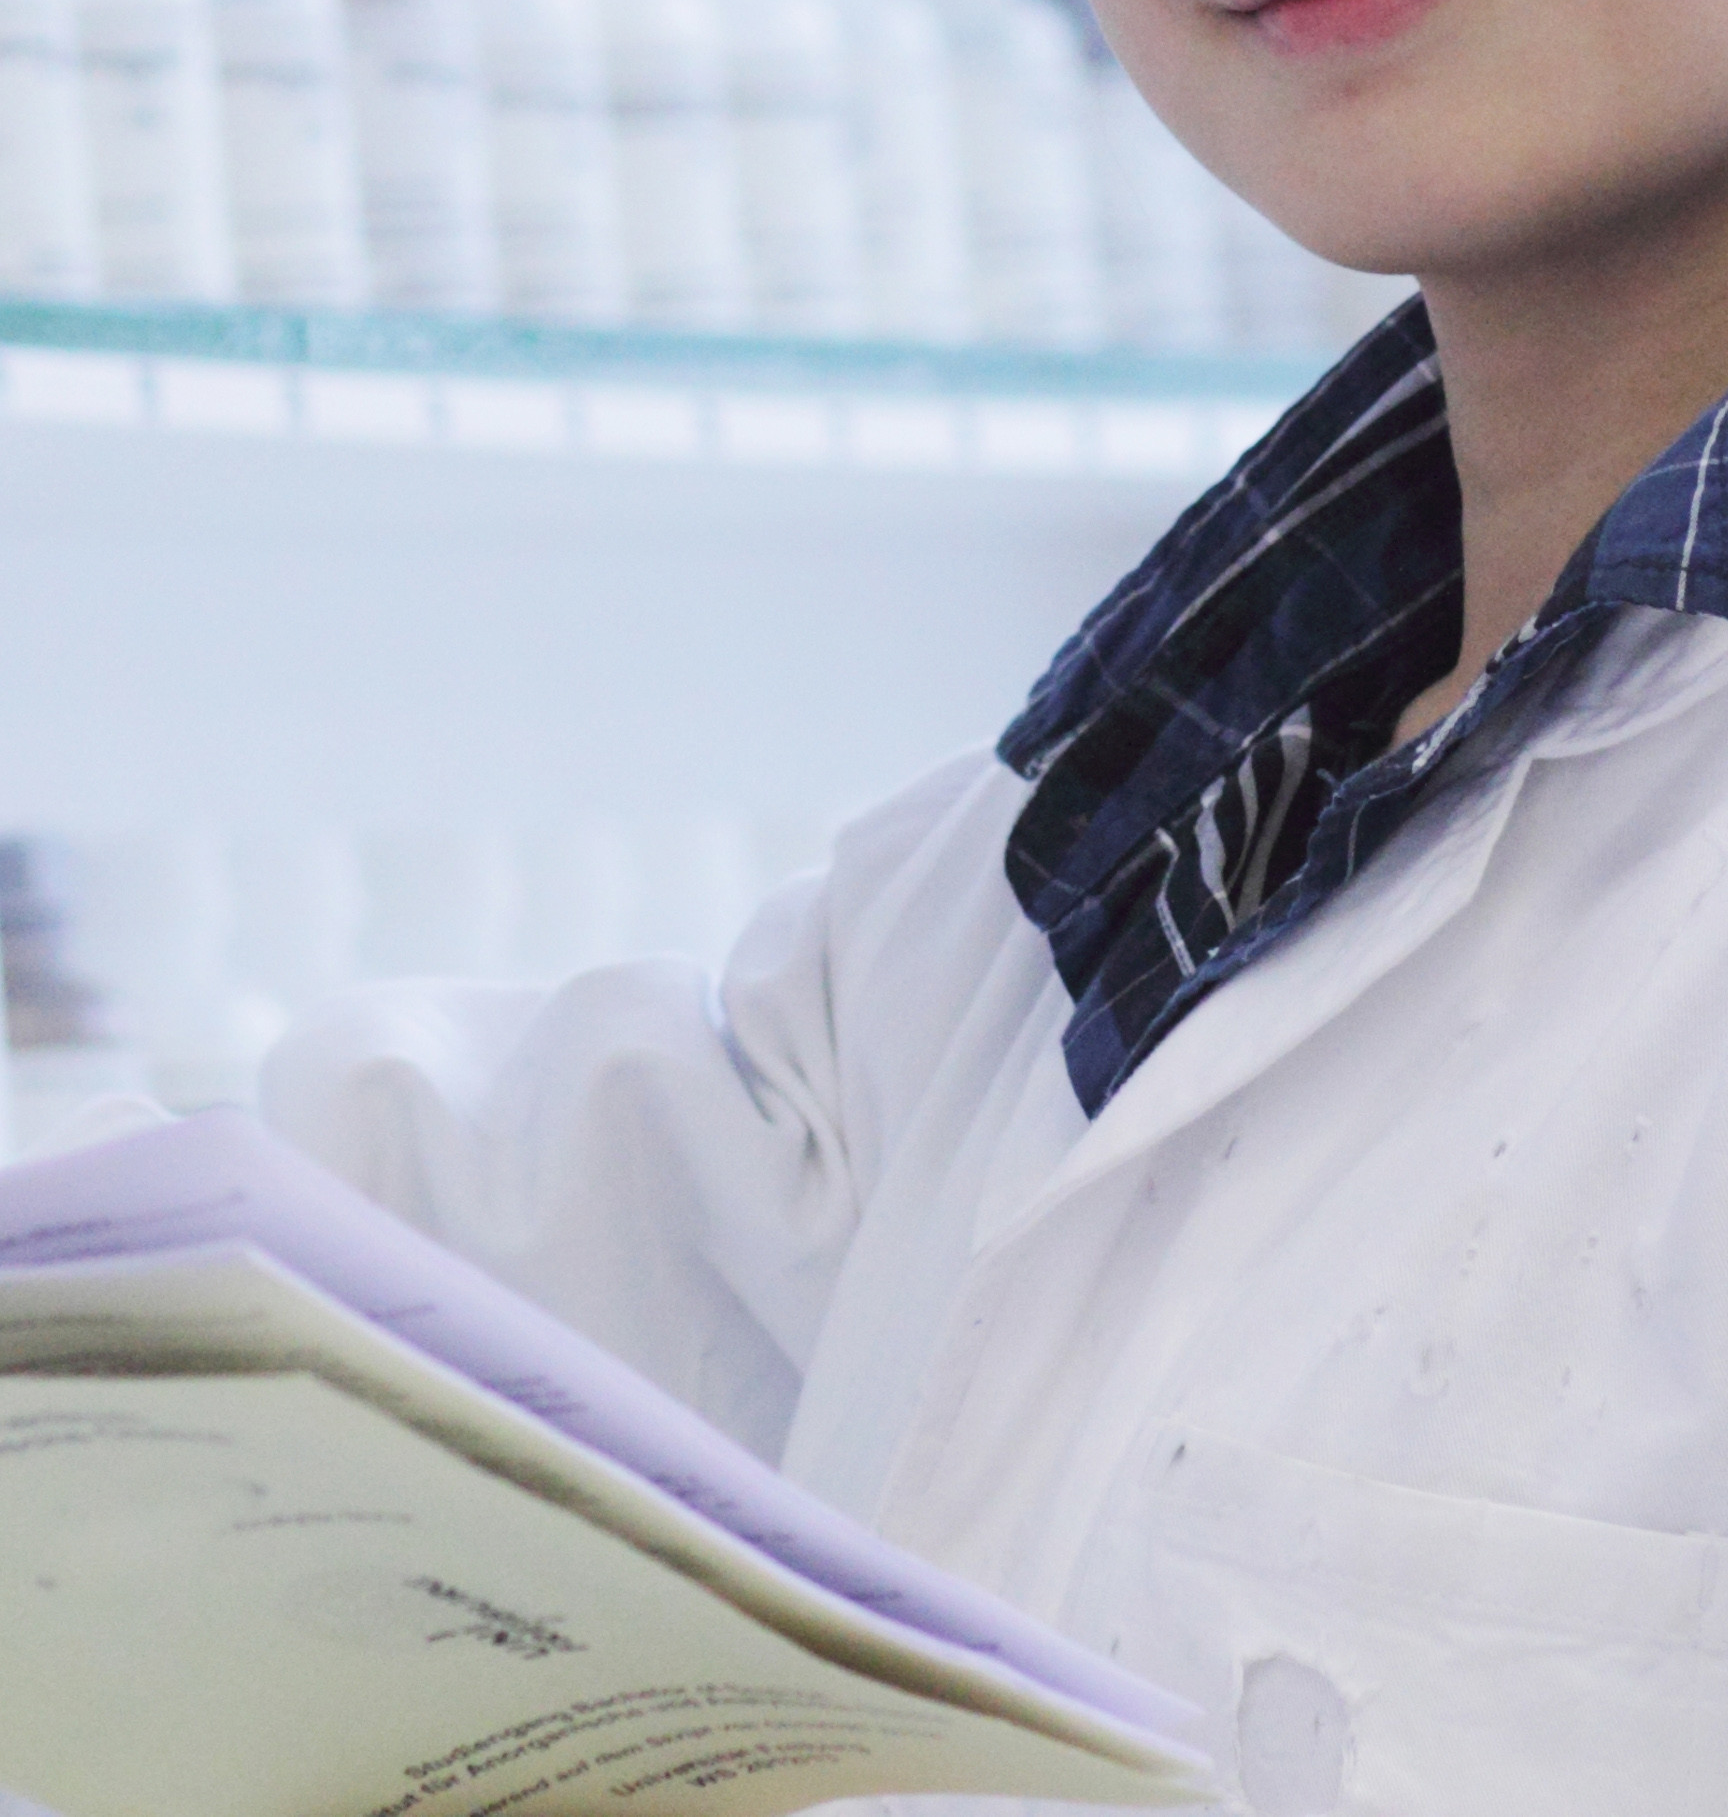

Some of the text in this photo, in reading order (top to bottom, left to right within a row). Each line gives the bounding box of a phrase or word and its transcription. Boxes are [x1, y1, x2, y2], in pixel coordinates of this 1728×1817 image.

[404, 1710, 573, 1779] Studiengang
[420, 1774, 460, 1795] für
[467, 1708, 644, 1776] Anorganische
[556, 1759, 589, 1783] auf
[595, 1744, 643, 1765] dem
